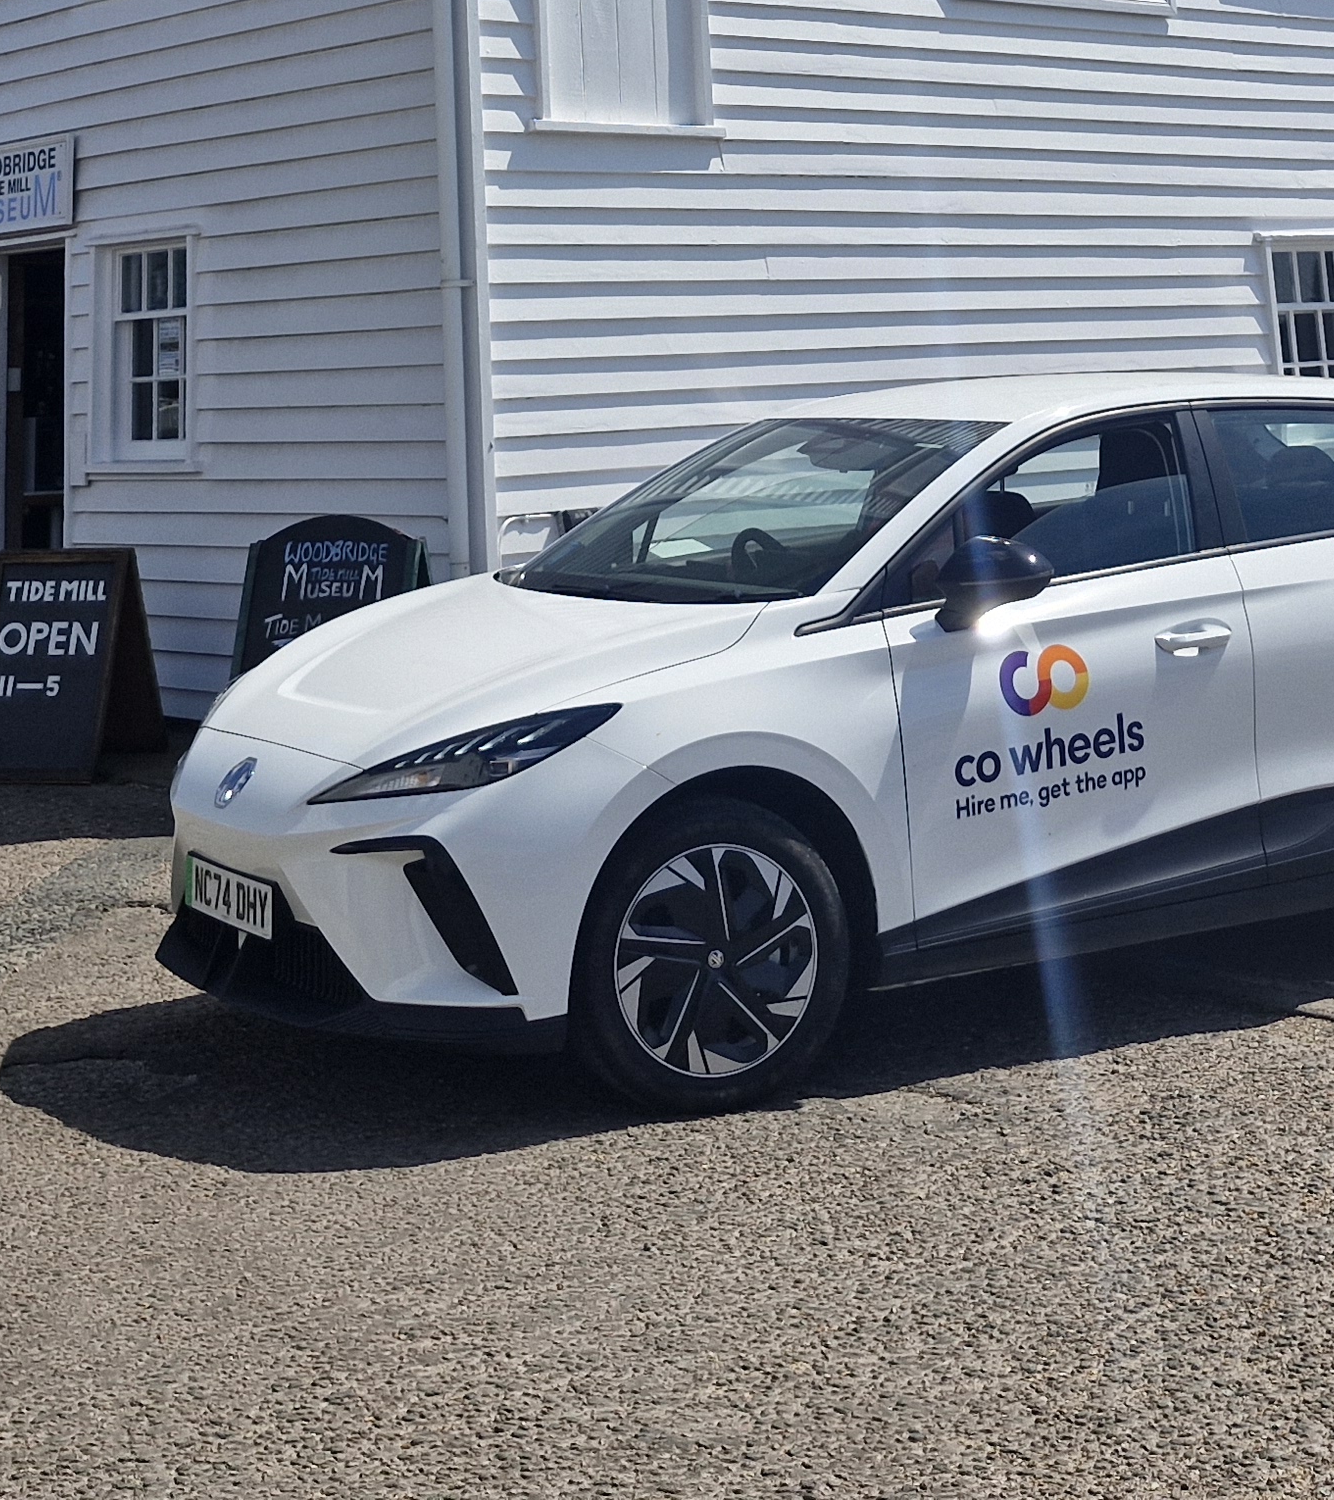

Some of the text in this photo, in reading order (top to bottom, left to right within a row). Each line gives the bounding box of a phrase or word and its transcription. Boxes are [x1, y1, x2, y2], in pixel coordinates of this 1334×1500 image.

[8, 177, 31, 194] MILL
[284, 540, 389, 564] WOODBRIDGE
[311, 567, 360, 580] TIDE MILL
[6, 579, 107, 603] TIDE MILL
[264, 613, 299, 639] TIDE
[955, 712, 1145, 788] co wheels
[955, 765, 1146, 819] Hire me, get the app
[195, 864, 268, 929] NC74 DHY
